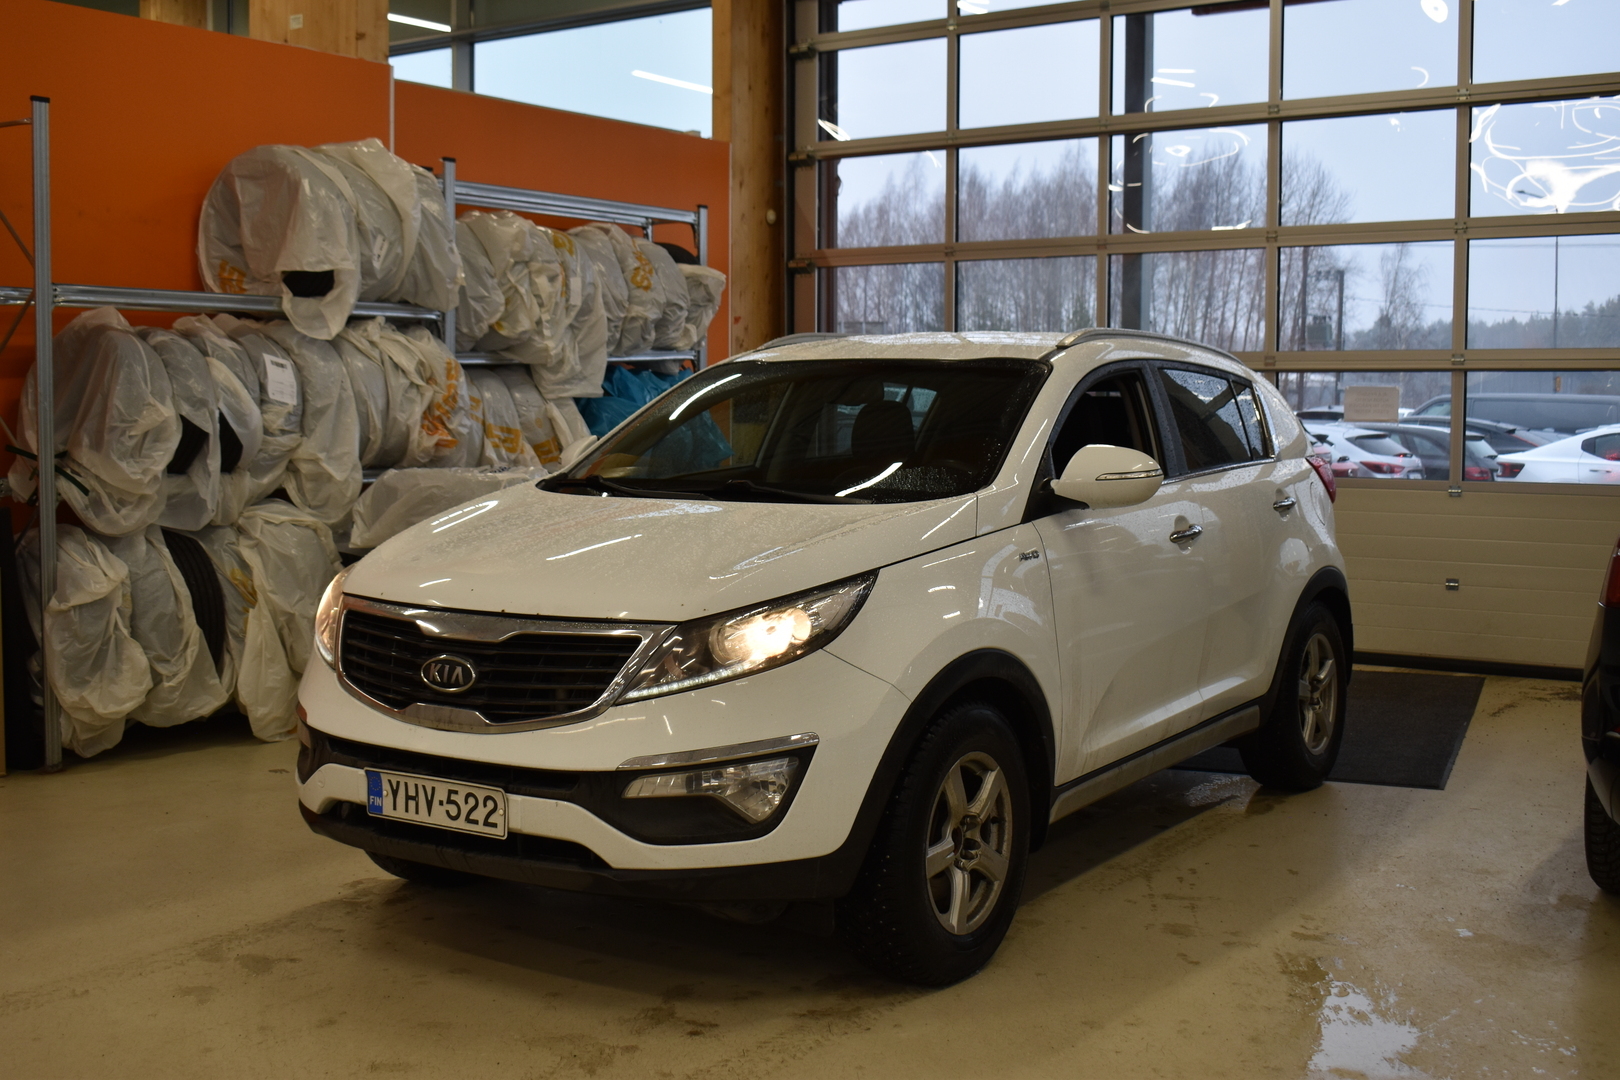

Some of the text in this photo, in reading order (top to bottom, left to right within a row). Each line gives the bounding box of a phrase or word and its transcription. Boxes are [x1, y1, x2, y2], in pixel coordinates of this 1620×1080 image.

[429, 662, 465, 686] KIA
[369, 795, 383, 807] FIN
[387, 778, 499, 829] YHV-522
